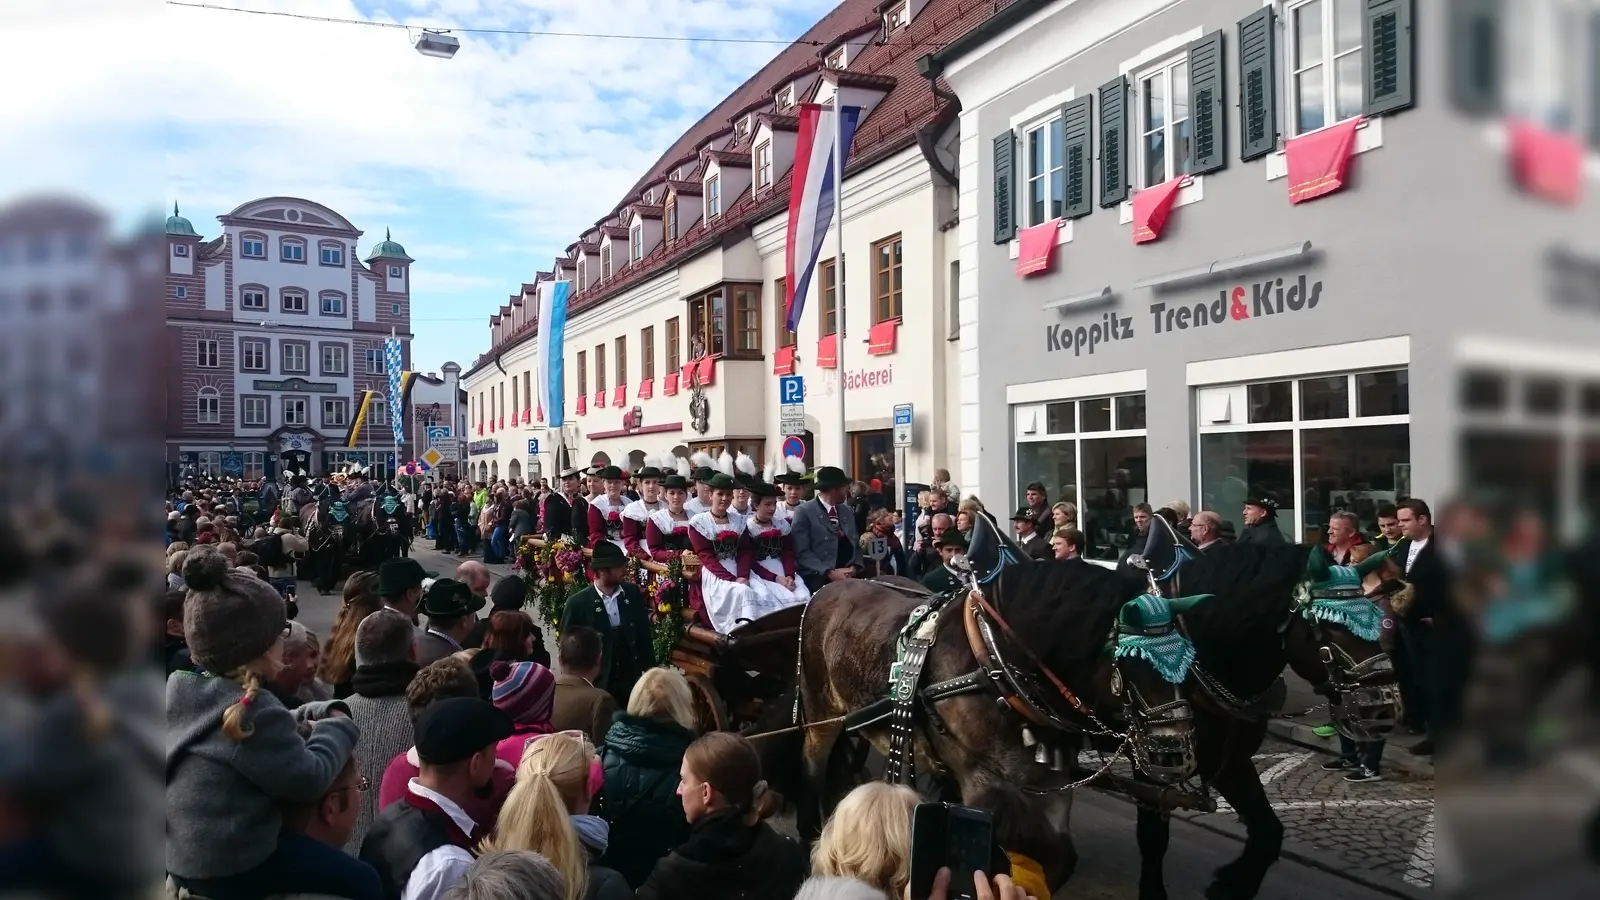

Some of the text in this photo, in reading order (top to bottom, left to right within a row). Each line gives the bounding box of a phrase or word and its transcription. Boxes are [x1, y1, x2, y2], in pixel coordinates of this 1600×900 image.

[1046, 312, 1134, 356] Koppitz
[842, 363, 893, 390] Bäckerei
[785, 380, 798, 400] P
[529, 440, 536, 453] P
[871, 541, 885, 554] 13
